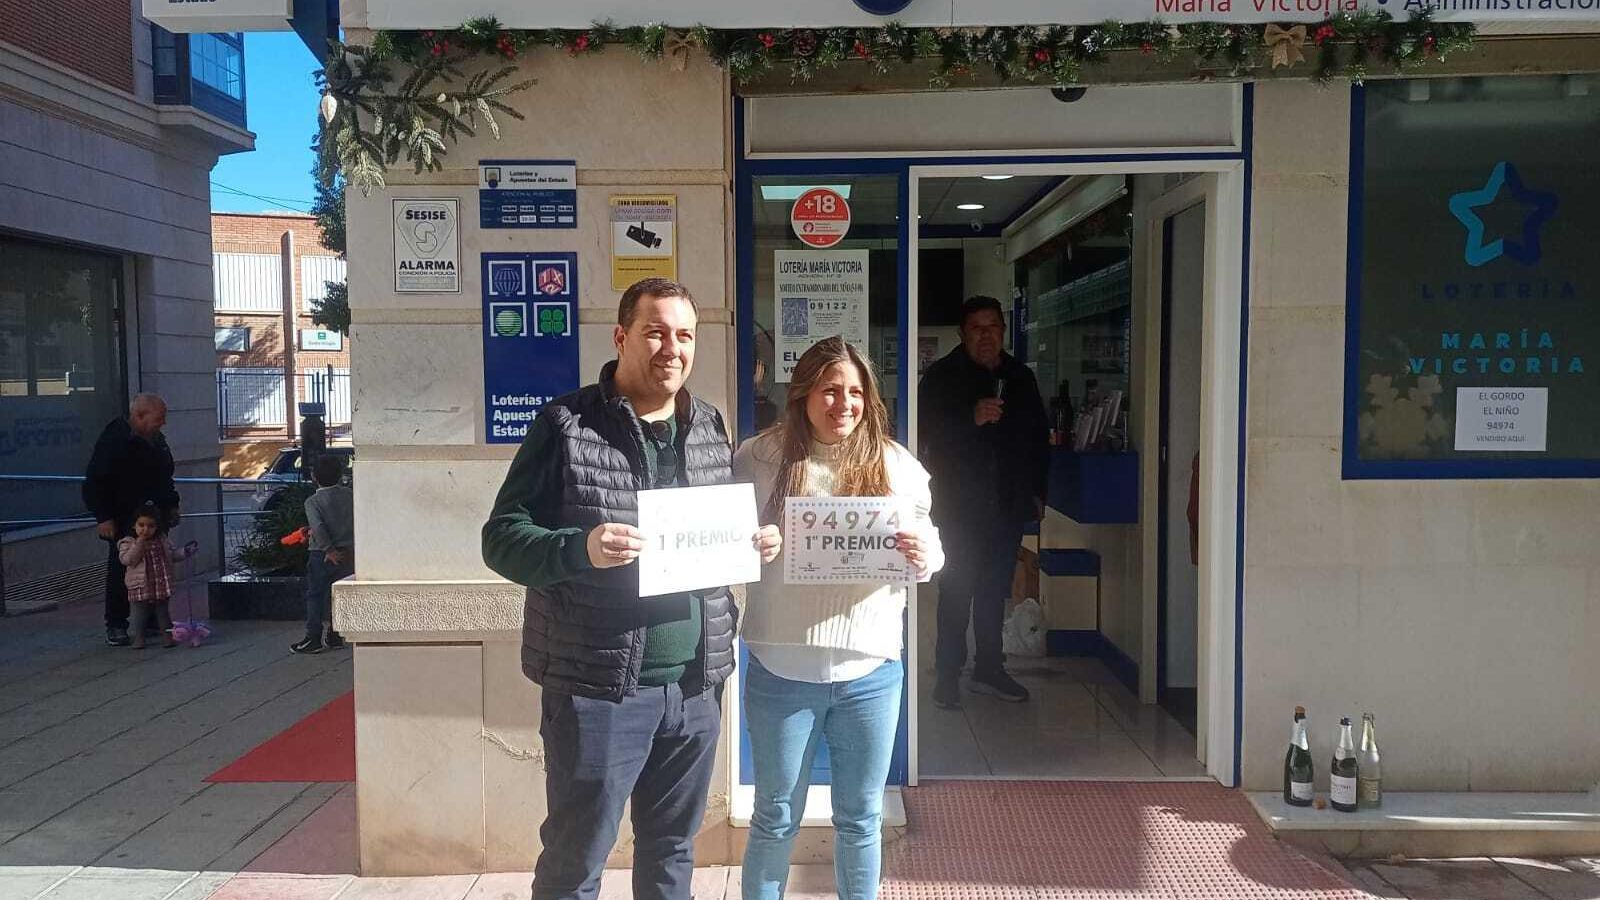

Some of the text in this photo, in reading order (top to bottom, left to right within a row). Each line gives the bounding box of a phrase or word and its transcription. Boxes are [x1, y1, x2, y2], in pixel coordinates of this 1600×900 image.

[804, 195, 835, 213] +18
[399, 260, 455, 270] ALARMA
[780, 259, 862, 273] LOTERÍA MARÍA VICTORIA
[810, 302, 847, 310] 09122
[1441, 328, 1553, 349] MARÍA
[783, 351, 801, 361] EL
[1408, 357, 1584, 374] VICTORIA
[491, 393, 543, 406] Loterías
[1479, 392, 1525, 400] EL GORDO
[1483, 404, 1519, 415] EL NIÑO
[493, 409, 537, 424] Apuest
[493, 424, 528, 437] Estad
[1486, 421, 1514, 430] 94974
[802, 510, 900, 530] 94974
[822, 535, 897, 550] PREMIO
